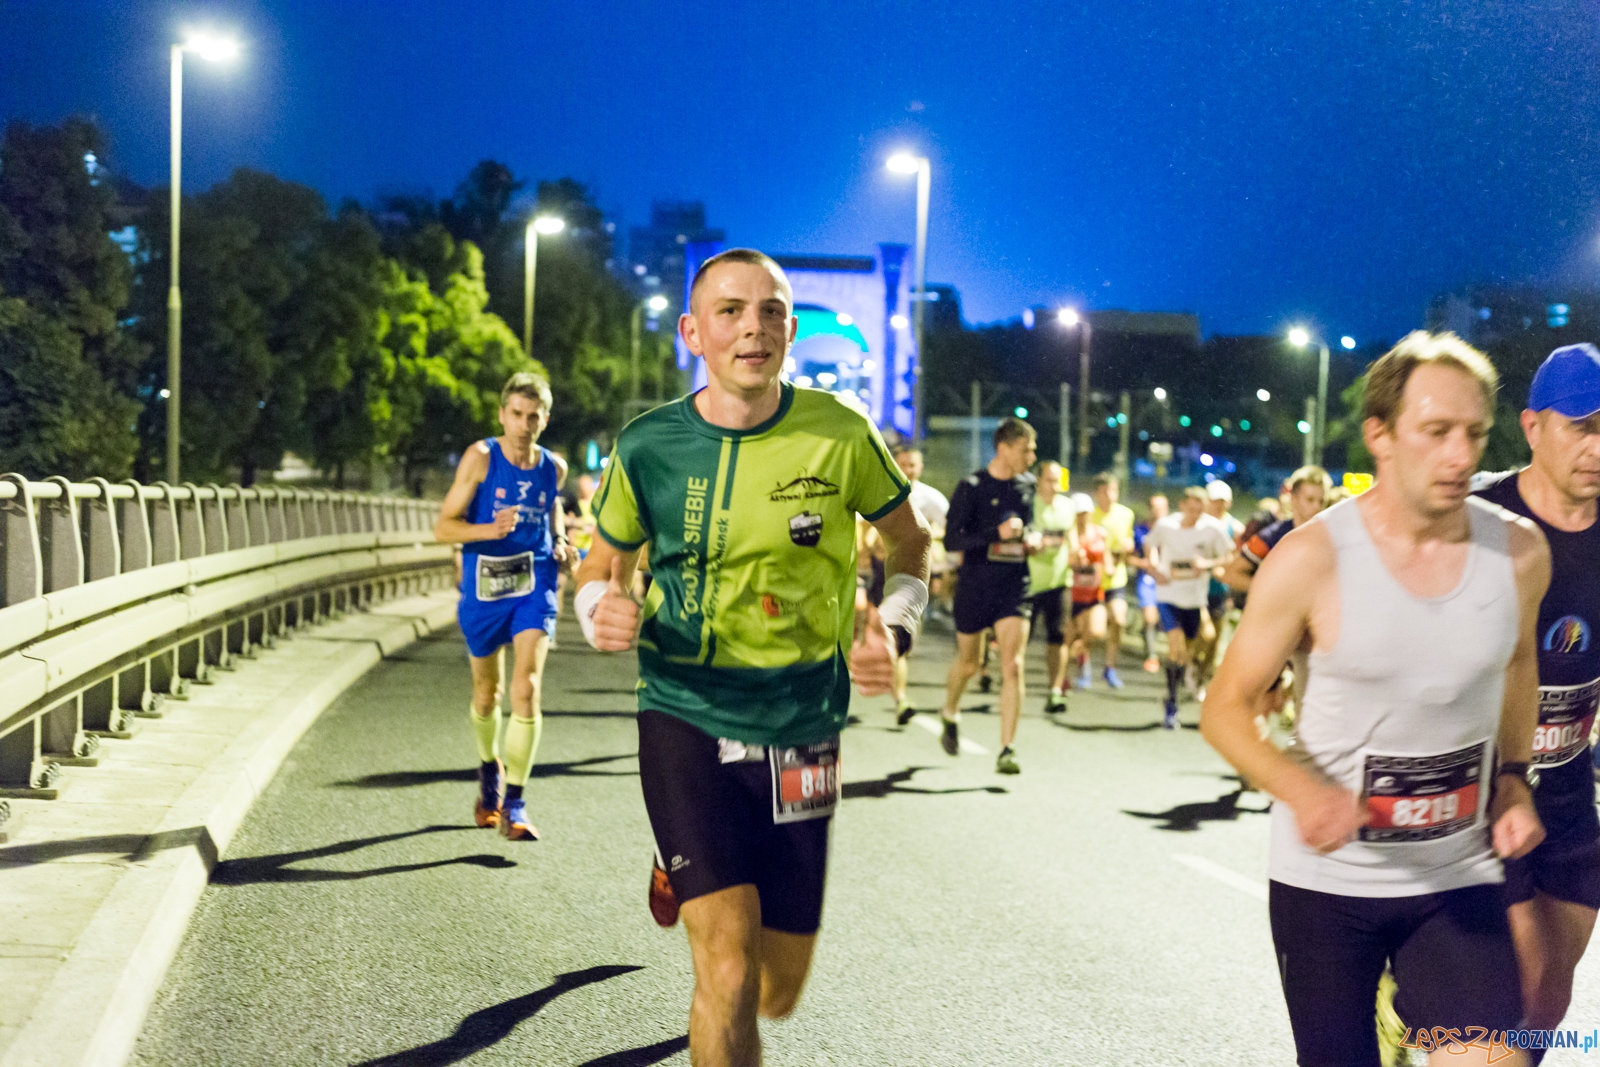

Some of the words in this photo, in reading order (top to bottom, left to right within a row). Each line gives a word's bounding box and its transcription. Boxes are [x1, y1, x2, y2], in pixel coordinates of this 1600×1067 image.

[684, 476, 708, 544] SIEBIE
[1532, 721, 1582, 751] 6002
[1391, 792, 1459, 827] 8219
